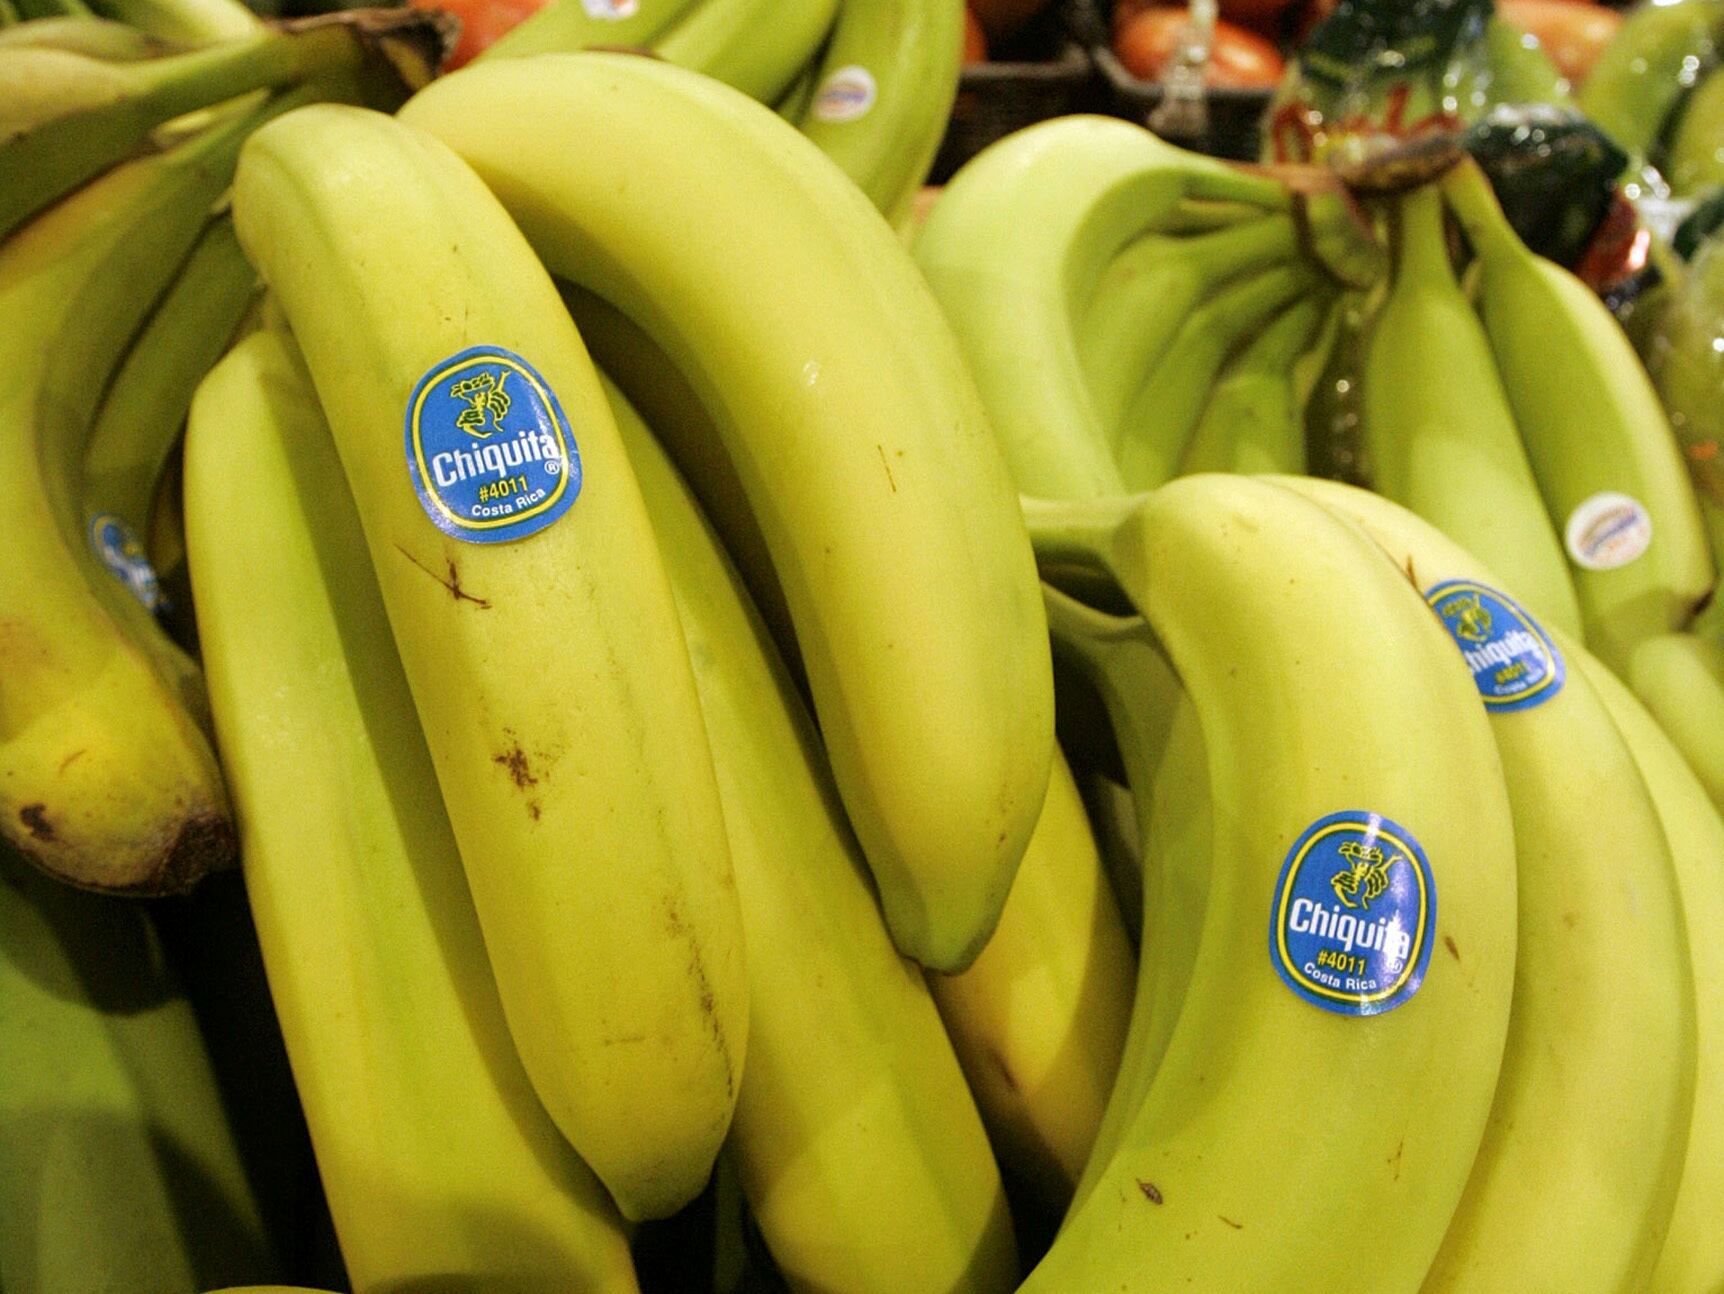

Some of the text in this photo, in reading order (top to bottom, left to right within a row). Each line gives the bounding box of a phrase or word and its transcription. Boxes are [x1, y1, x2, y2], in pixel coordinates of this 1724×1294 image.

[432, 430, 559, 487] Chiquita
[471, 488, 546, 517] Costa Rica
[479, 475, 528, 502] #4011
[1463, 629, 1544, 674] hiquita
[1304, 962, 1377, 990] Costa Rica
[1317, 950, 1366, 976] #4011
